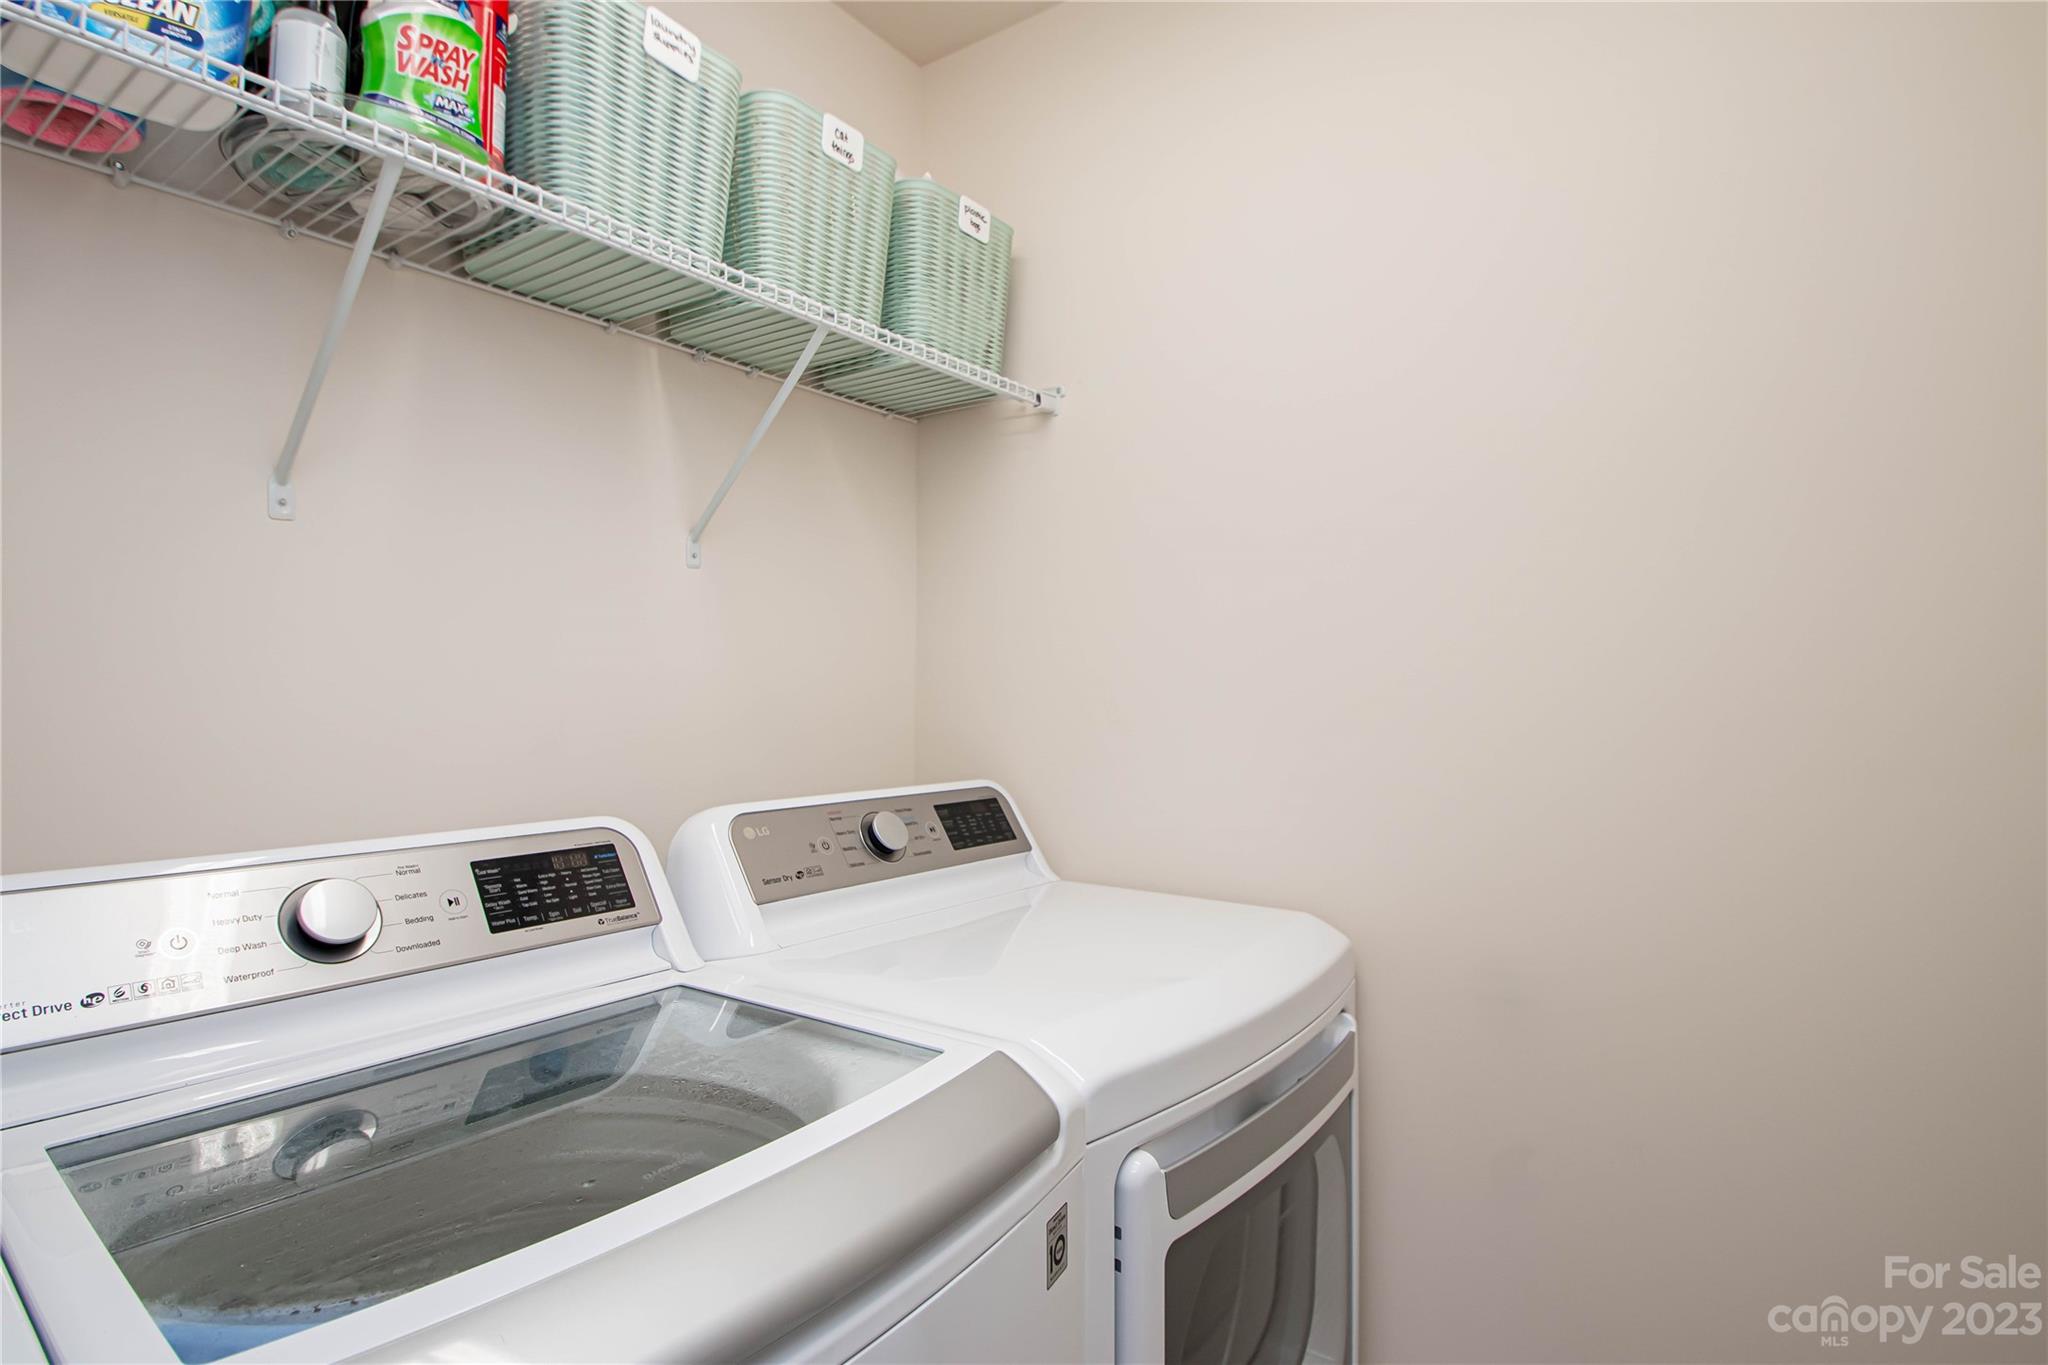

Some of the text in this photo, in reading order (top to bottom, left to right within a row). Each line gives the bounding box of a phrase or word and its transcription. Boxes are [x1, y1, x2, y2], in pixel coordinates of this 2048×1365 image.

[397, 24, 476, 71] SPRAY
[397, 50, 470, 92] WASH
[395, 867, 421, 876] Normal
[395, 892, 428, 902] Delicates
[242, 914, 263, 923] Duty
[404, 915, 434, 925] Bedding
[217, 941, 268, 955] Deep Wash
[395, 939, 441, 953] Downloaded
[224, 968, 275, 984] Waterproof
[0, 1001, 26, 1010] rter
[0, 1001, 73, 1022] ect Drive
